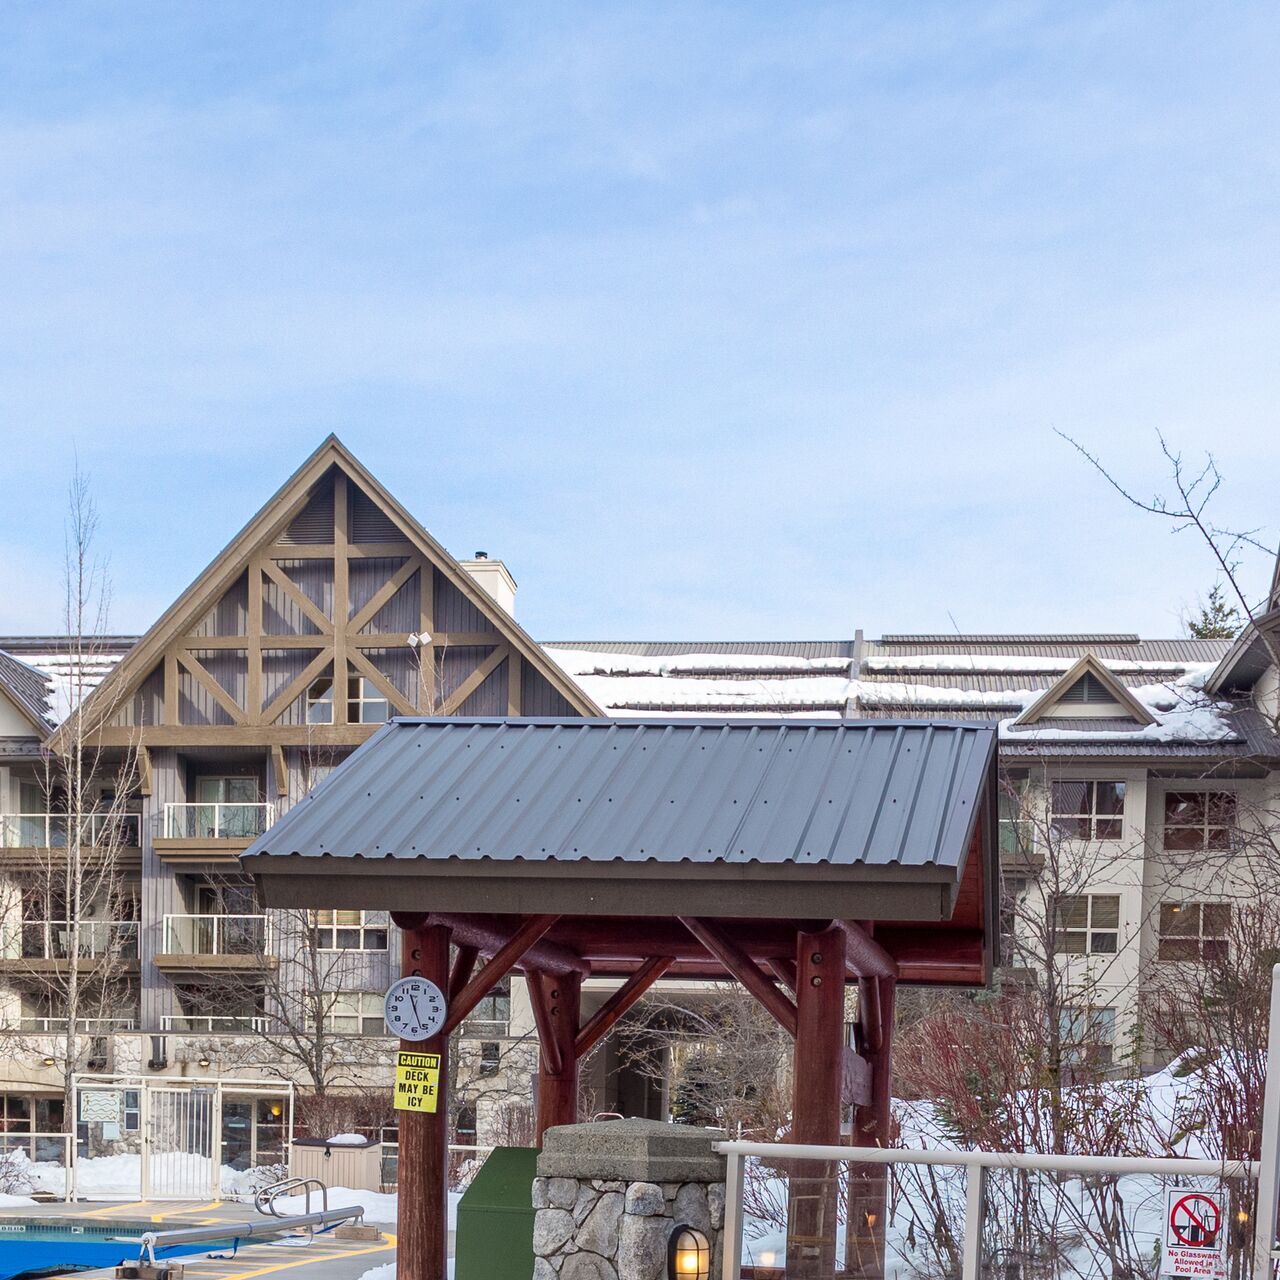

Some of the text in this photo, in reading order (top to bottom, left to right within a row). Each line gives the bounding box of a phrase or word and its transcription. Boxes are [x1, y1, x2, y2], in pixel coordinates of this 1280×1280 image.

[400, 1056, 436, 1067] CAUTION
[405, 1071, 429, 1082] DECK
[399, 1083, 434, 1095] MAY BE
[408, 1097, 423, 1107] ICY
[1181, 1251, 1220, 1259] Glassware
